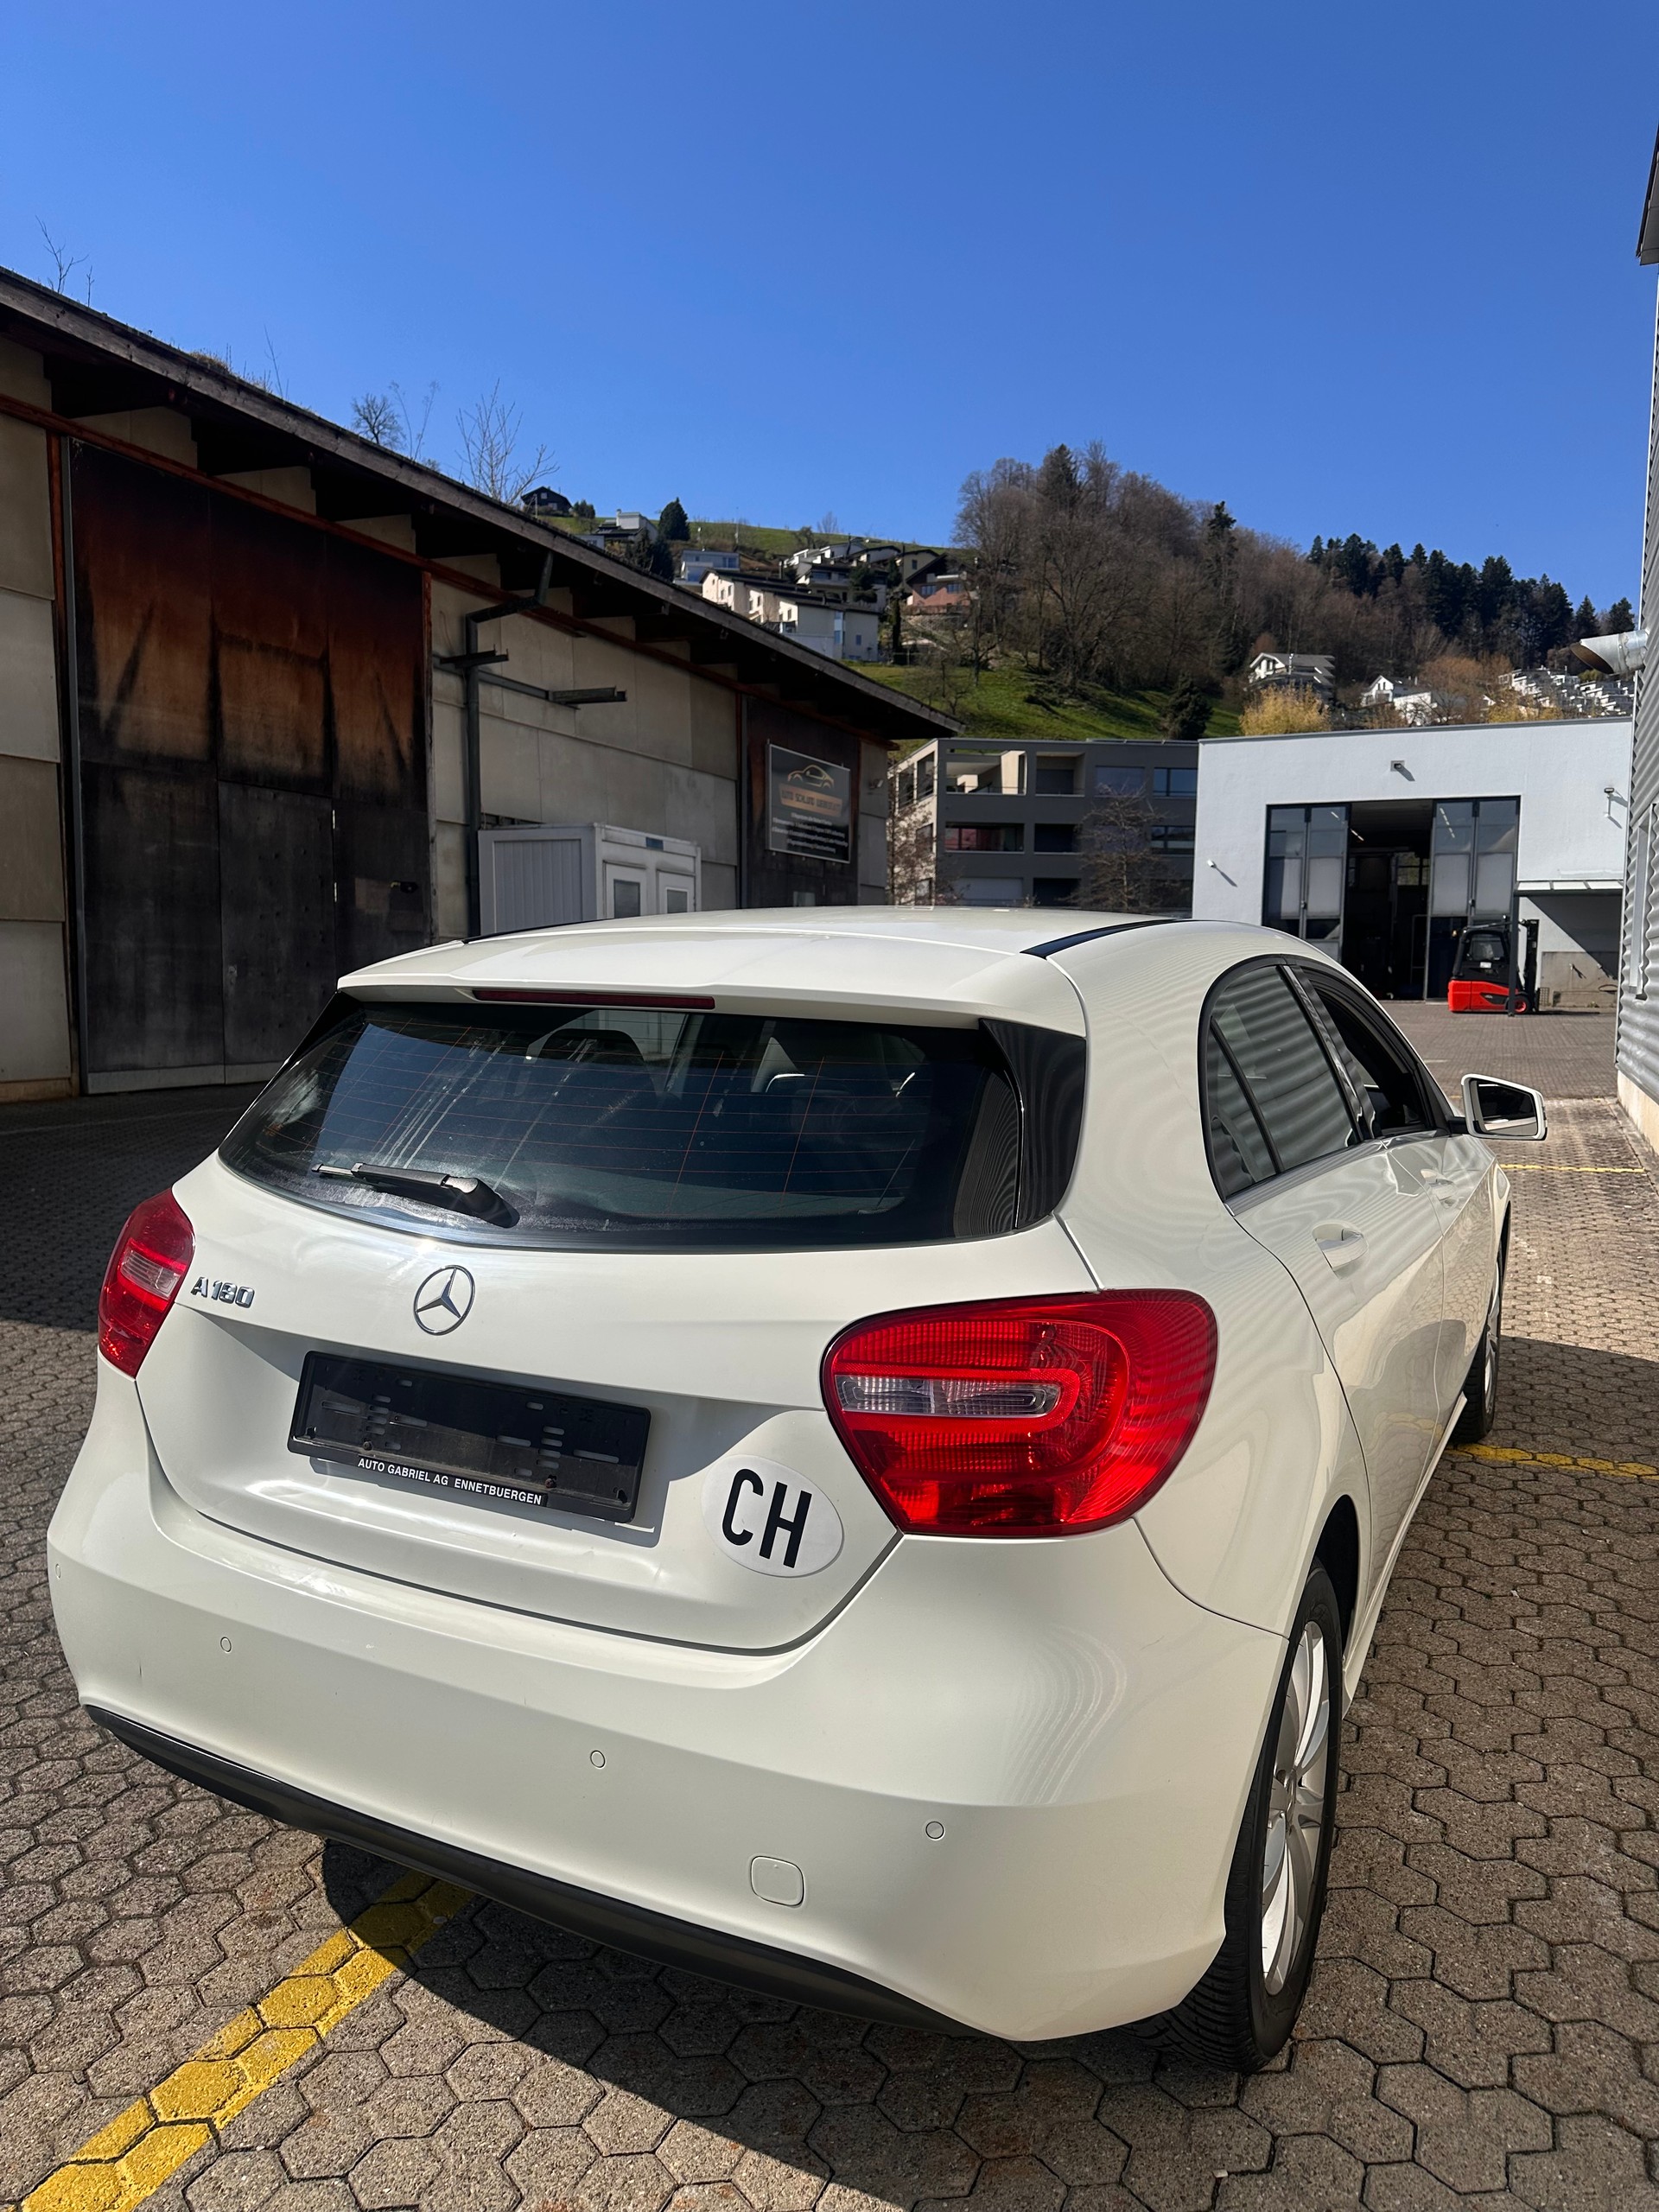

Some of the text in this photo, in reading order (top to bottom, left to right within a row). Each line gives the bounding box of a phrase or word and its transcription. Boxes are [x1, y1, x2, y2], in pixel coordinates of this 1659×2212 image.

[190, 1276, 256, 1308] A 180
[358, 1458, 543, 1505] AUTO GABRIEL AG ENNETBUERGEN
[721, 1468, 813, 1569] CH
